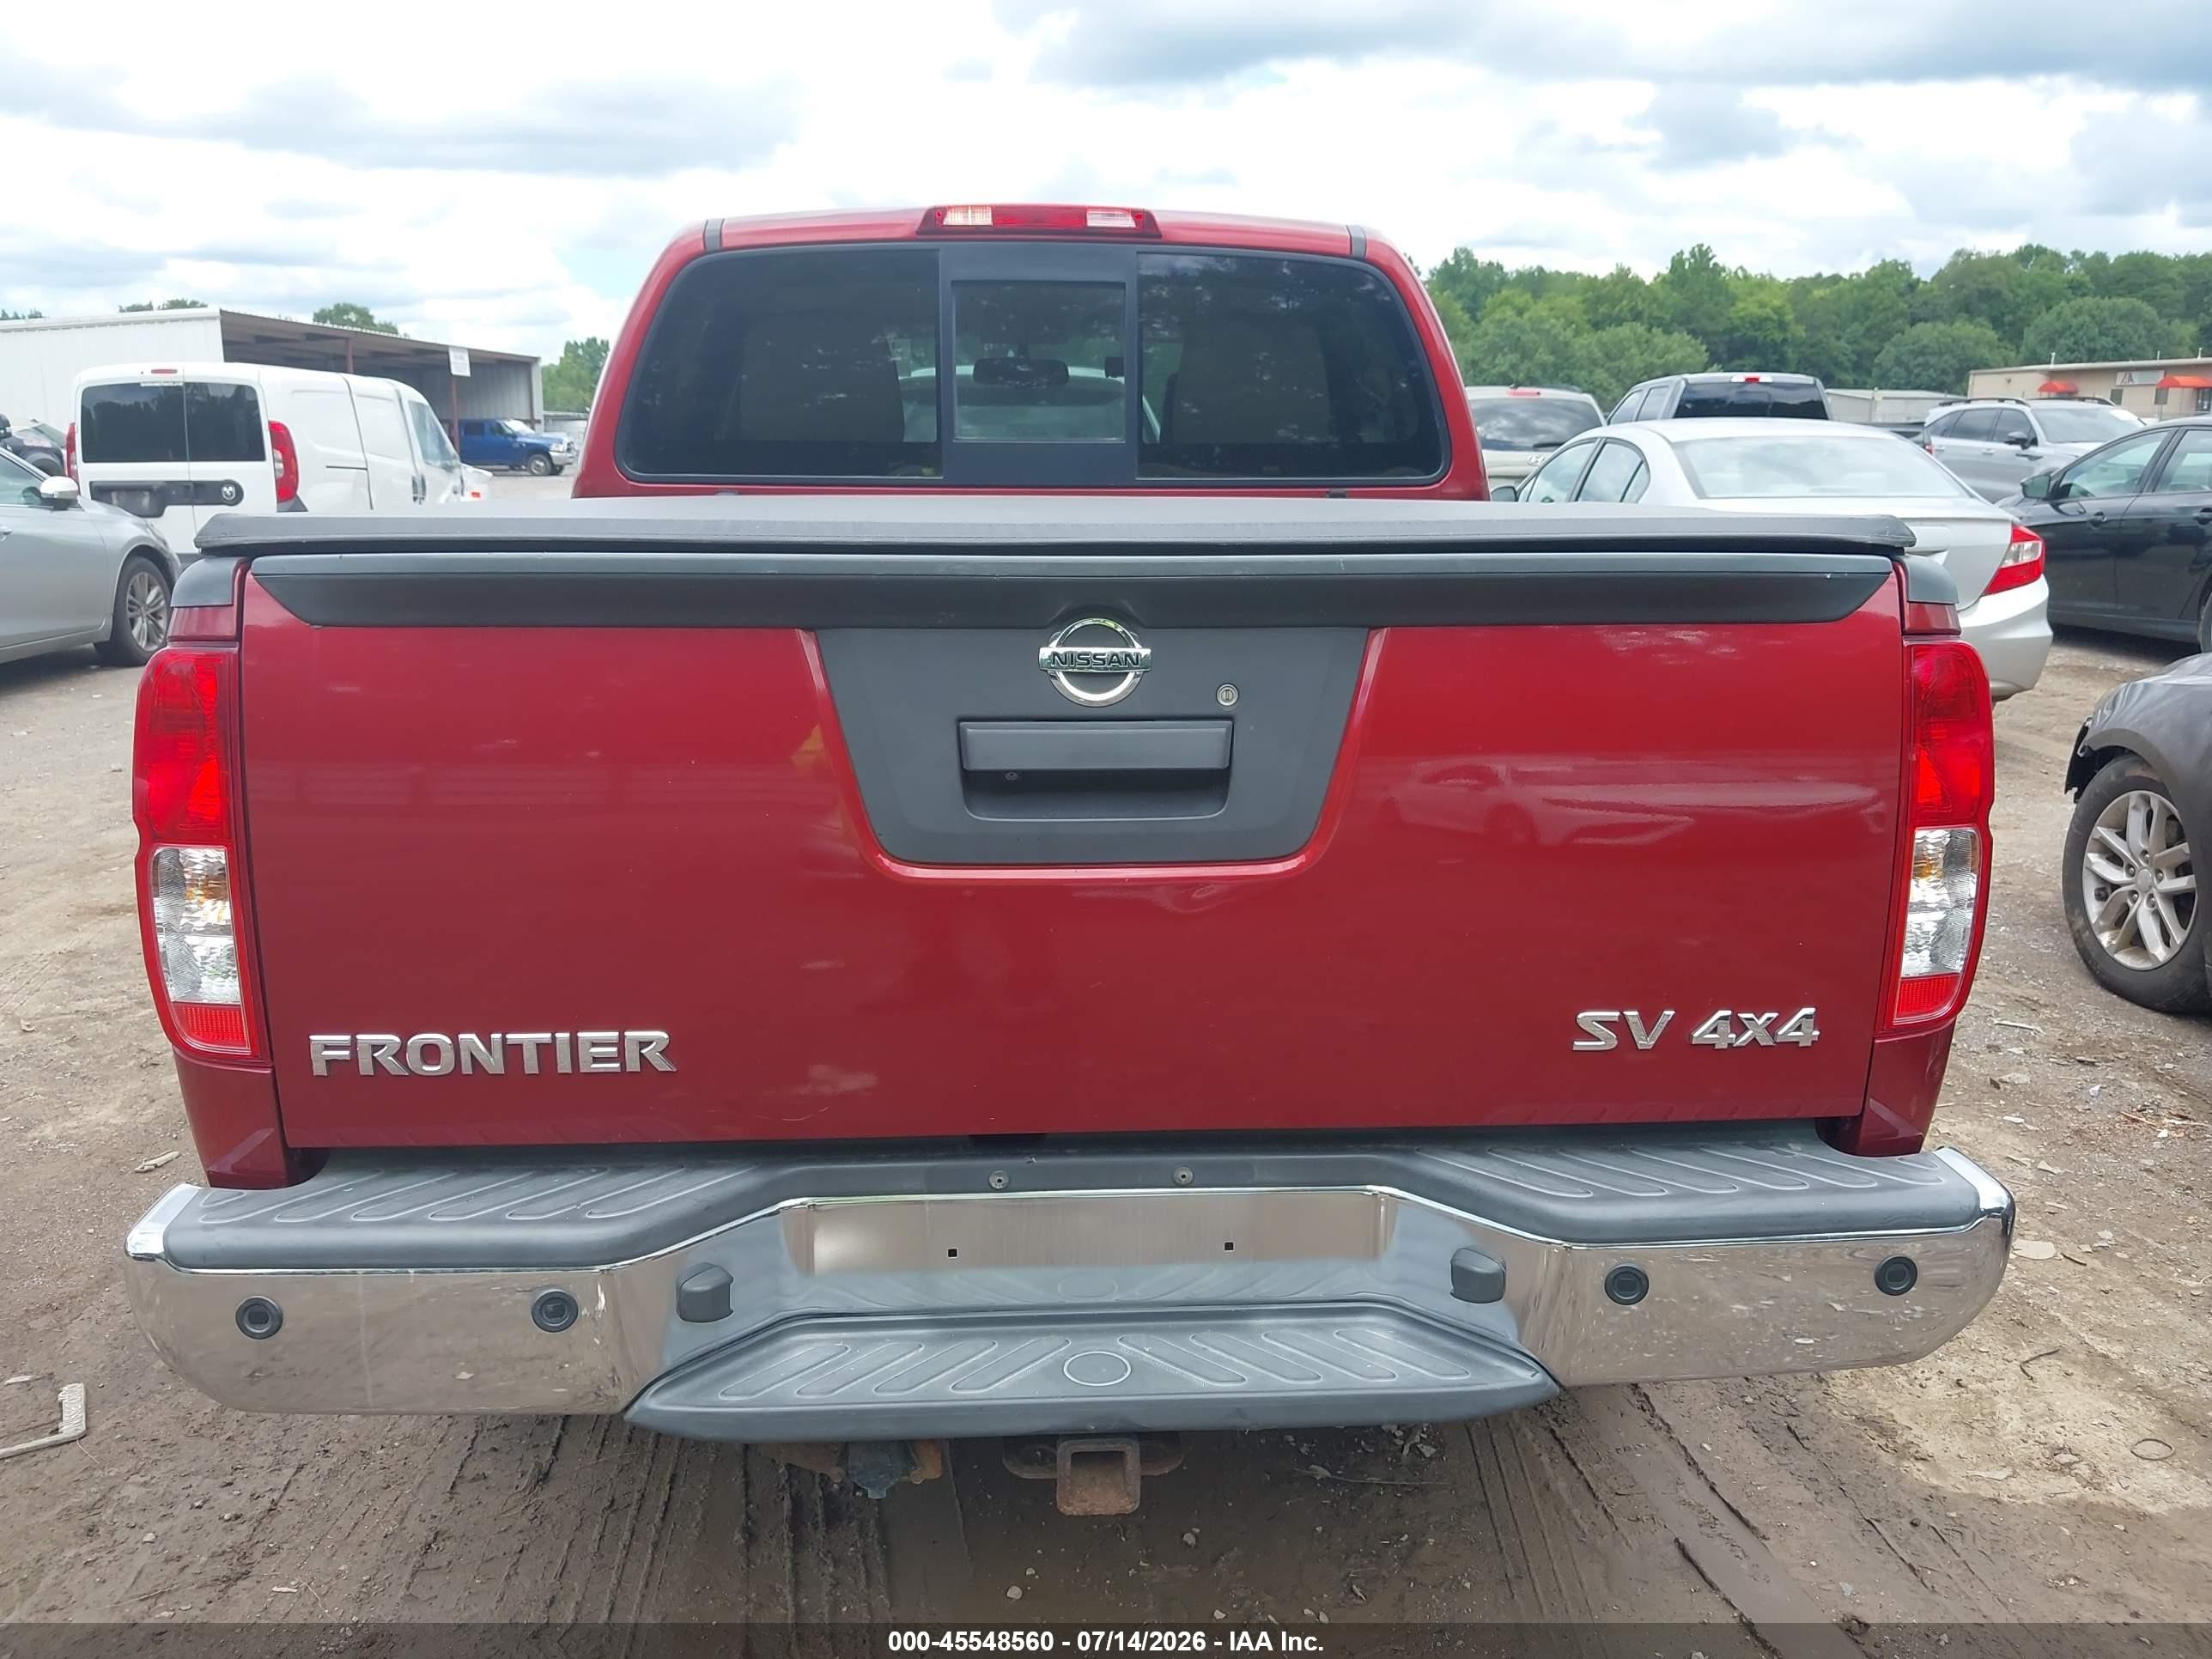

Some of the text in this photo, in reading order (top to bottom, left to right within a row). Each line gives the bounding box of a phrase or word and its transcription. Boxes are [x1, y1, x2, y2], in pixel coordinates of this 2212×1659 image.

[1051, 651, 1141, 668] NISSAN
[1572, 1007, 1820, 1051] SV 4x4
[308, 1030, 677, 1076] FRONTIER
